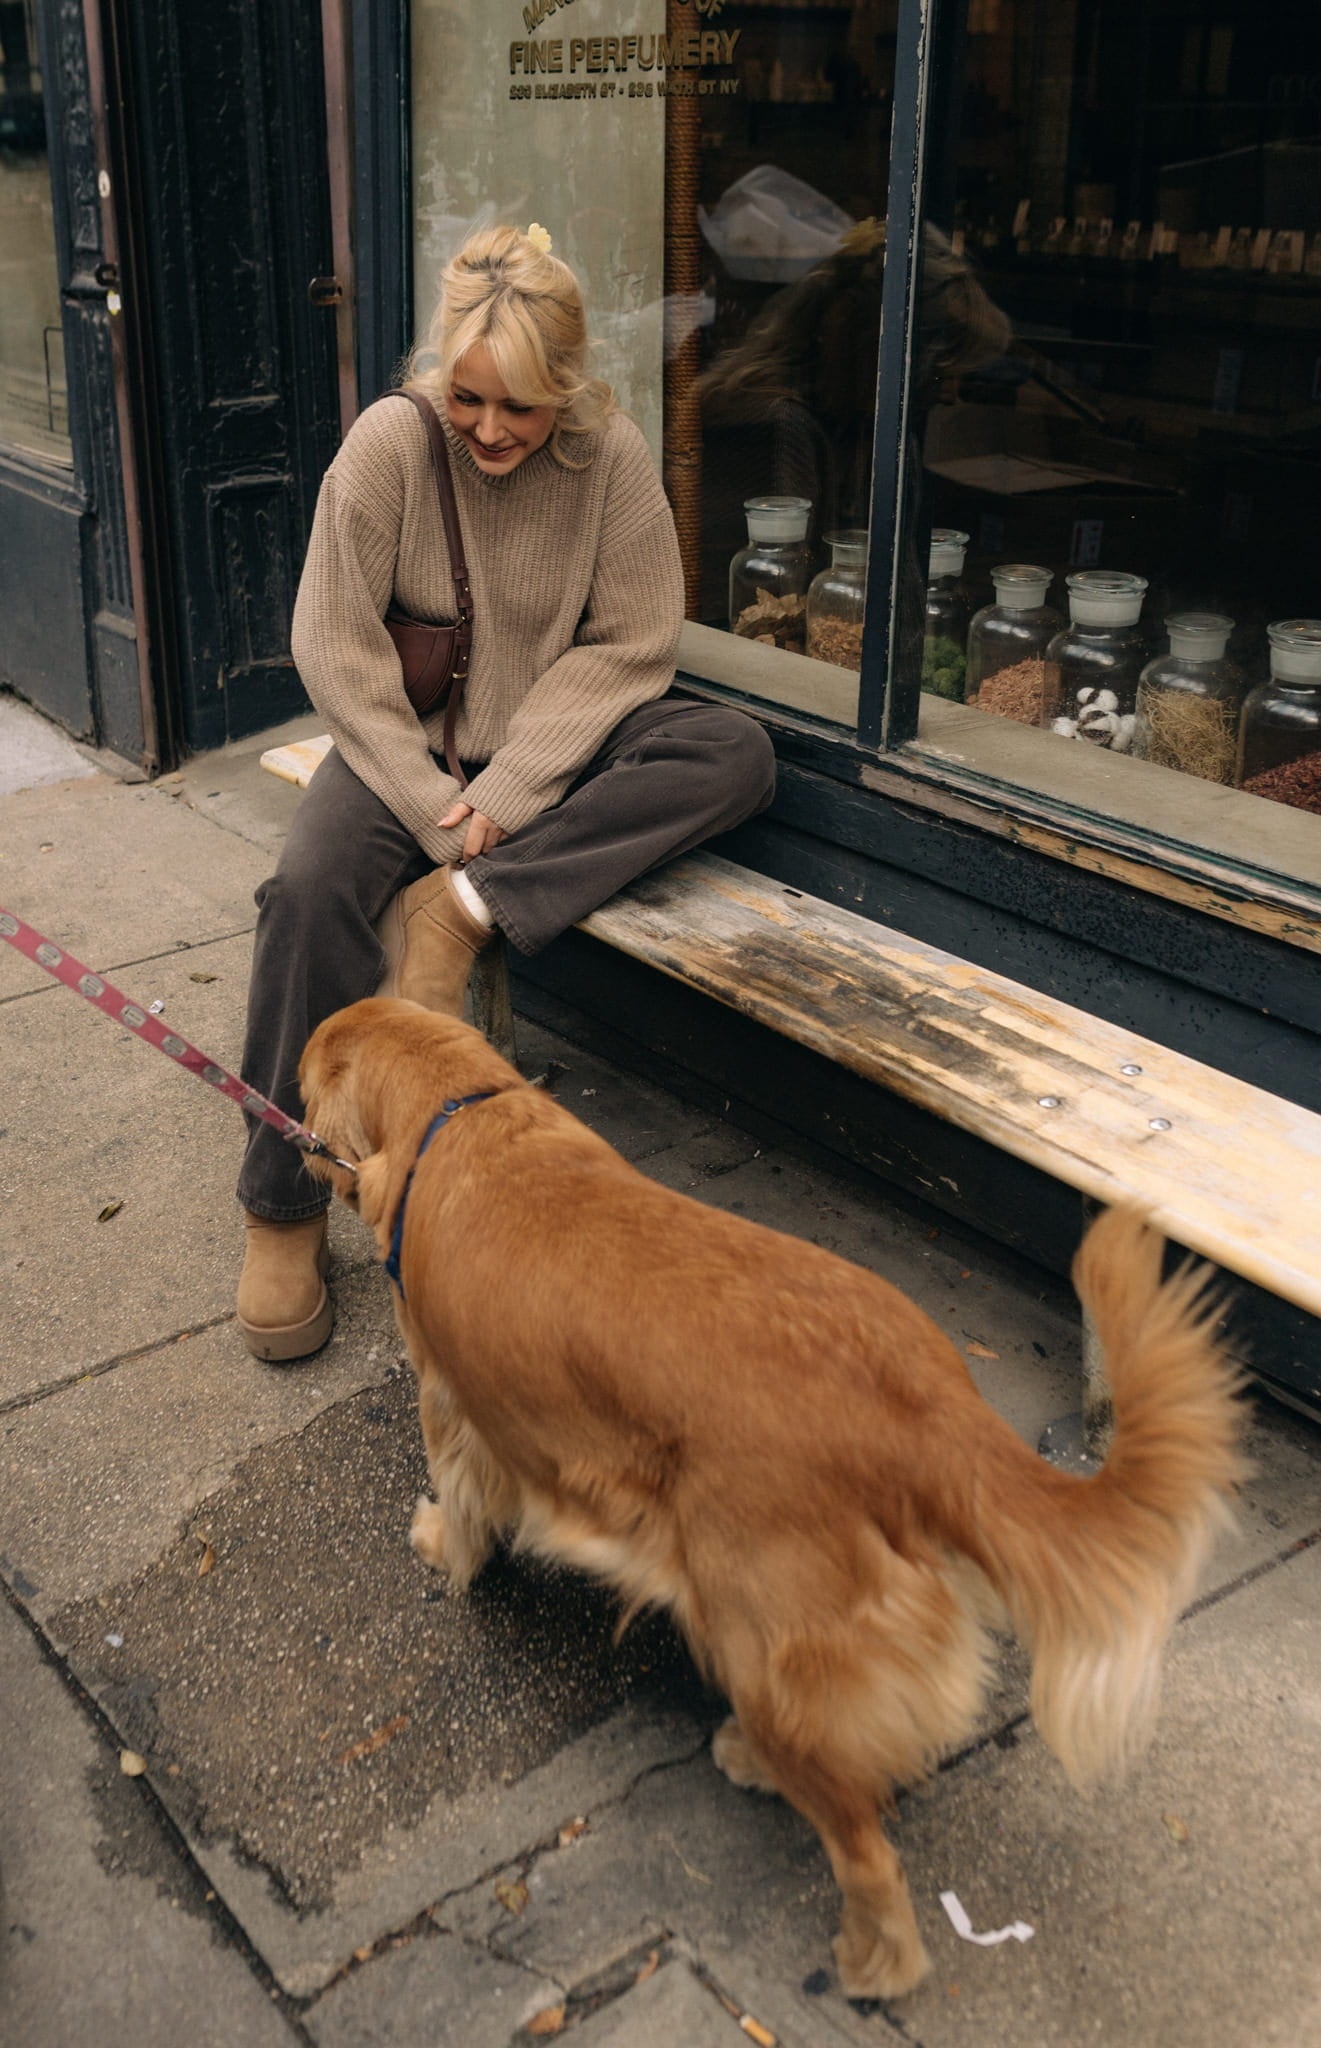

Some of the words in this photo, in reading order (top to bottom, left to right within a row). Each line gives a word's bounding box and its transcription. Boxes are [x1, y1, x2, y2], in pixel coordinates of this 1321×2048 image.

[510, 38, 563, 74] FINE
[570, 29, 741, 73] PERFUMERY
[534, 82, 596, 100] ELIZABETH
[600, 82, 616, 98] ST
[698, 79, 716, 96] ST
[719, 78, 740, 95] NY
